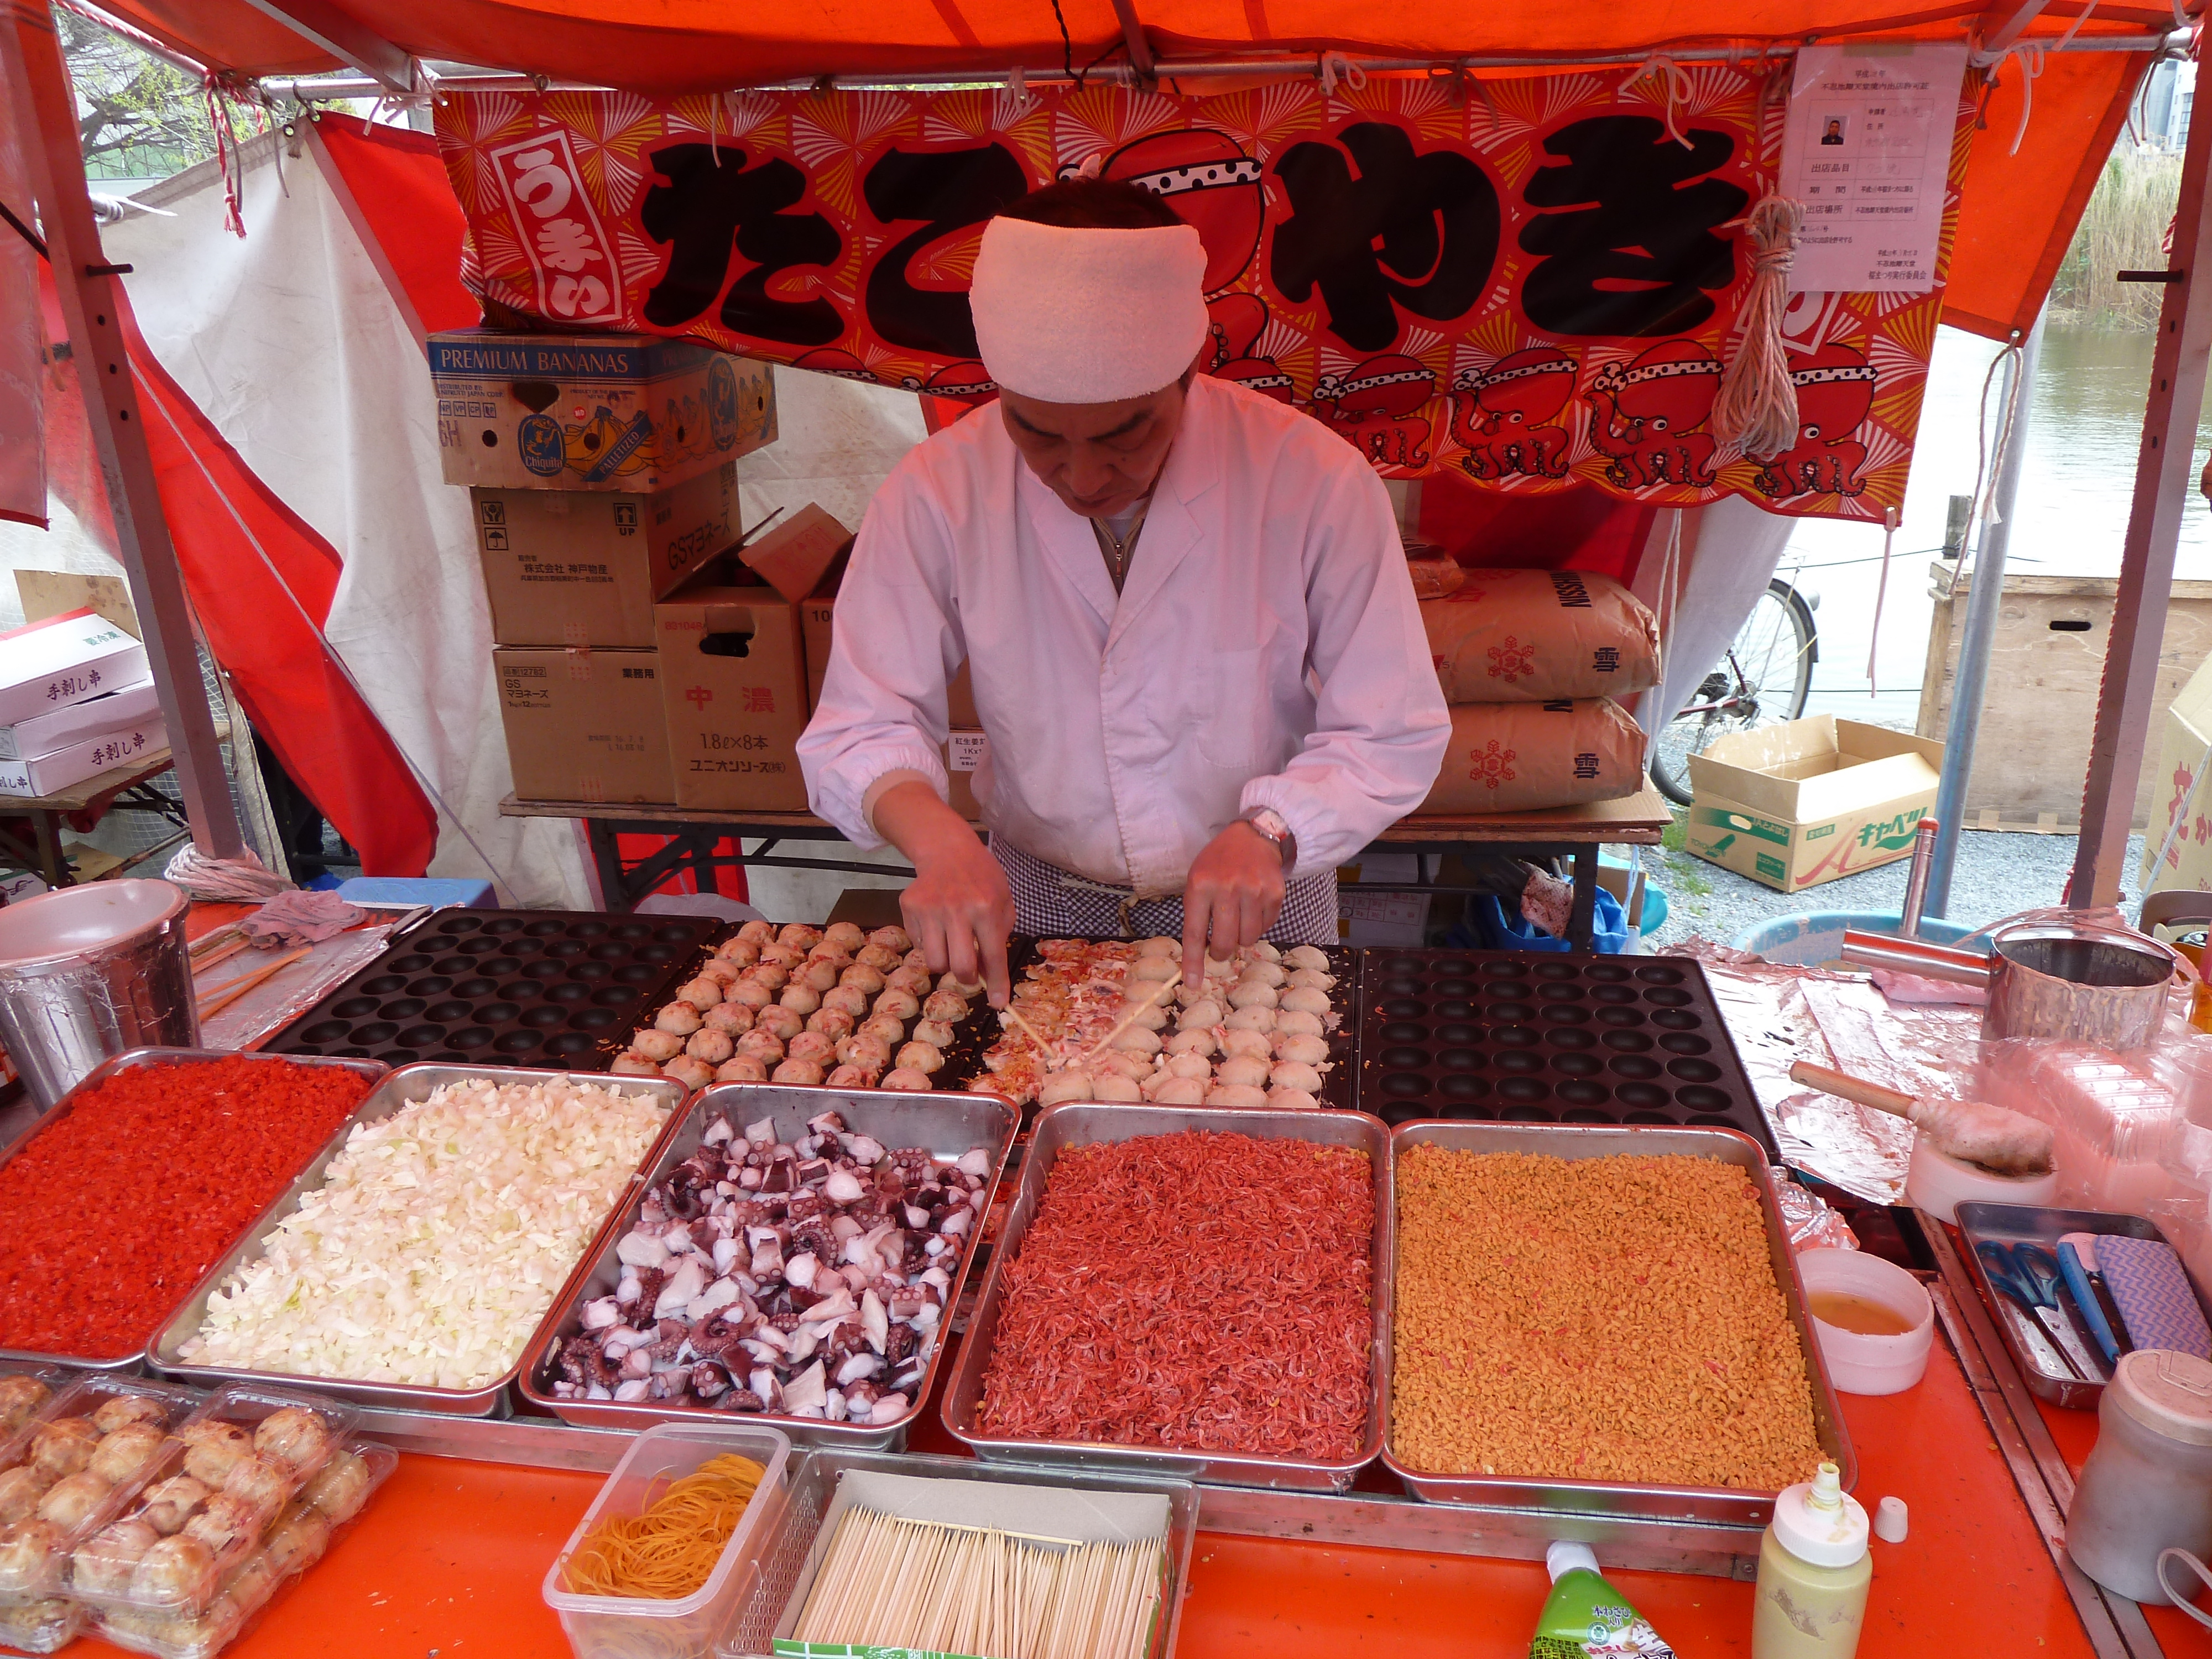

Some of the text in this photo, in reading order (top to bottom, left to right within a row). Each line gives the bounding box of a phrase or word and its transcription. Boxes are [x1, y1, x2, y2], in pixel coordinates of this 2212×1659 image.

[1811, 163, 1850, 174] 出店品目
[1806, 205, 1843, 215] 出店場所
[514, 148, 611, 317] うまい
[441, 349, 629, 373] PREMIUM BANANAS
[598, 431, 640, 474] PALLETIZED
[525, 456, 563, 469] Chiquita
[619, 527, 635, 536] UP
[668, 509, 731, 571] GSマヨネーズ
[524, 564, 608, 575] 株式会社 神戸物産
[622, 668, 655, 679] 業務用
[46, 669, 102, 701] 手刺し串
[505, 679, 521, 688] GS
[506, 689, 549, 698] マヨネーズ
[685, 685, 776, 713] 中濃
[91, 732, 146, 765] 手刺し串
[1857, 806, 1928, 847] キャベツ
[1593, 1604, 1631, 1618] 本わさび
[1631, 1623, 1666, 1651] 生
